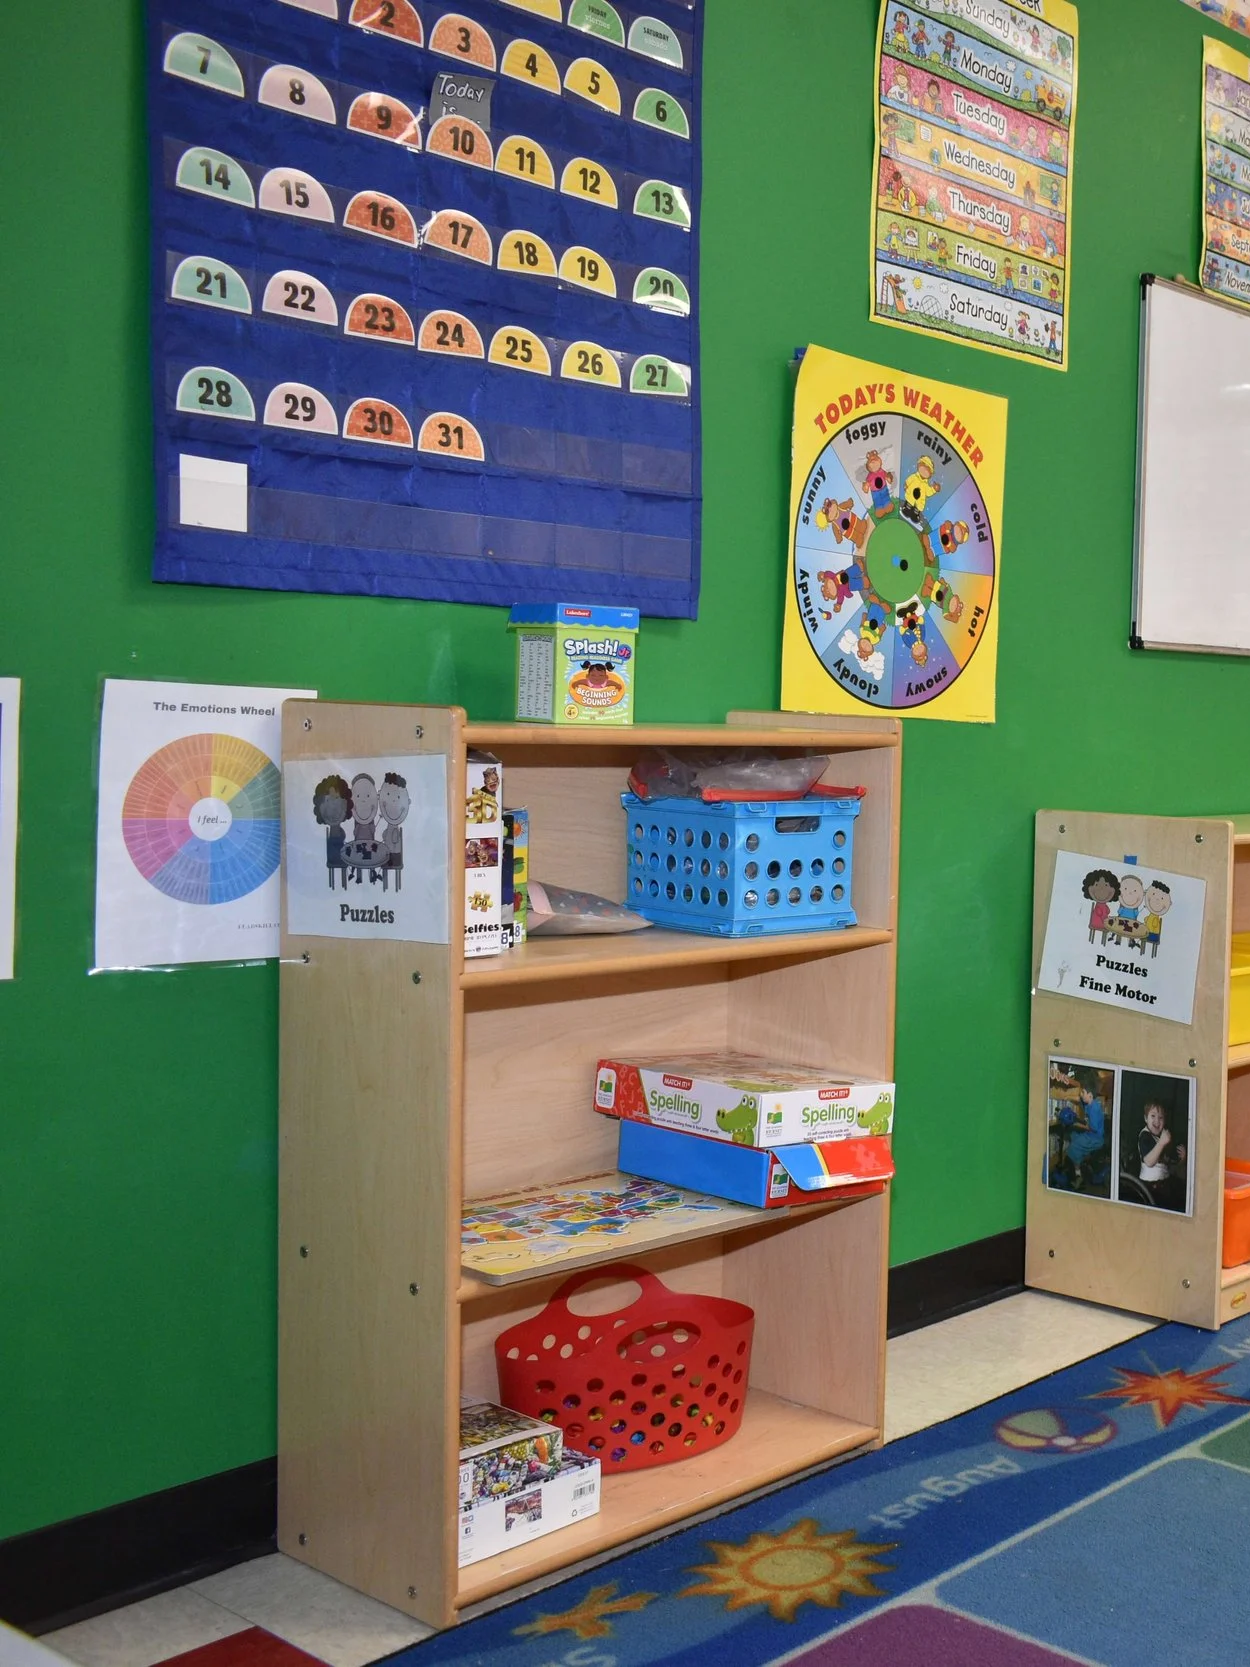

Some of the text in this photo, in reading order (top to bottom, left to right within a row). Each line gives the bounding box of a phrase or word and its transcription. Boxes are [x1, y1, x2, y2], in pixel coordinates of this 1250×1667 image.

[643, 27, 669, 42] SATURDAY
[966, 0, 1010, 38] Sunday
[379, 1, 667, 122] 2 3 4 5 6
[960, 50, 1013, 93] Monday
[438, 73, 484, 100] Today
[196, 46, 674, 214] 7 8 9 10 11 12 13
[953, 92, 1006, 135] Tuesday
[944, 141, 1015, 187] Wednesday
[199, 158, 674, 297] 14 15 16 17 18 19 20
[950, 191, 1010, 233] Thursday
[956, 245, 996, 279] Friday
[195, 267, 668, 388] 21 22 23 24 25 26 27
[950, 293, 1008, 331] Saturday
[198, 378, 464, 450] 28 29 30 31
[814, 384, 985, 470] TODAY'S WEATHER
[846, 420, 886, 444] foggy
[917, 430, 952, 466] rainy
[802, 465, 826, 525] sunny
[970, 503, 988, 543] cold
[798, 568, 819, 633] windy
[968, 605, 985, 638] hot
[576, 687, 617, 699] BEGINNING
[833, 658, 879, 698] cloudy
[905, 666, 948, 697] snowy
[153, 702, 275, 716] The Emotions Wheel
[582, 697, 612, 706] SOUNDS
[201, 815, 218, 825] feel
[340, 904, 395, 924] Puzzles
[1096, 955, 1148, 978] Puzzles
[1079, 976, 1157, 1005] Fine Motor
[664, 1078, 681, 1087] MATCH
[820, 1090, 838, 1099] MATCH
[650, 1090, 700, 1119] Spelling
[802, 1103, 855, 1128] Spelling
[868, 1455, 1021, 1529] August
